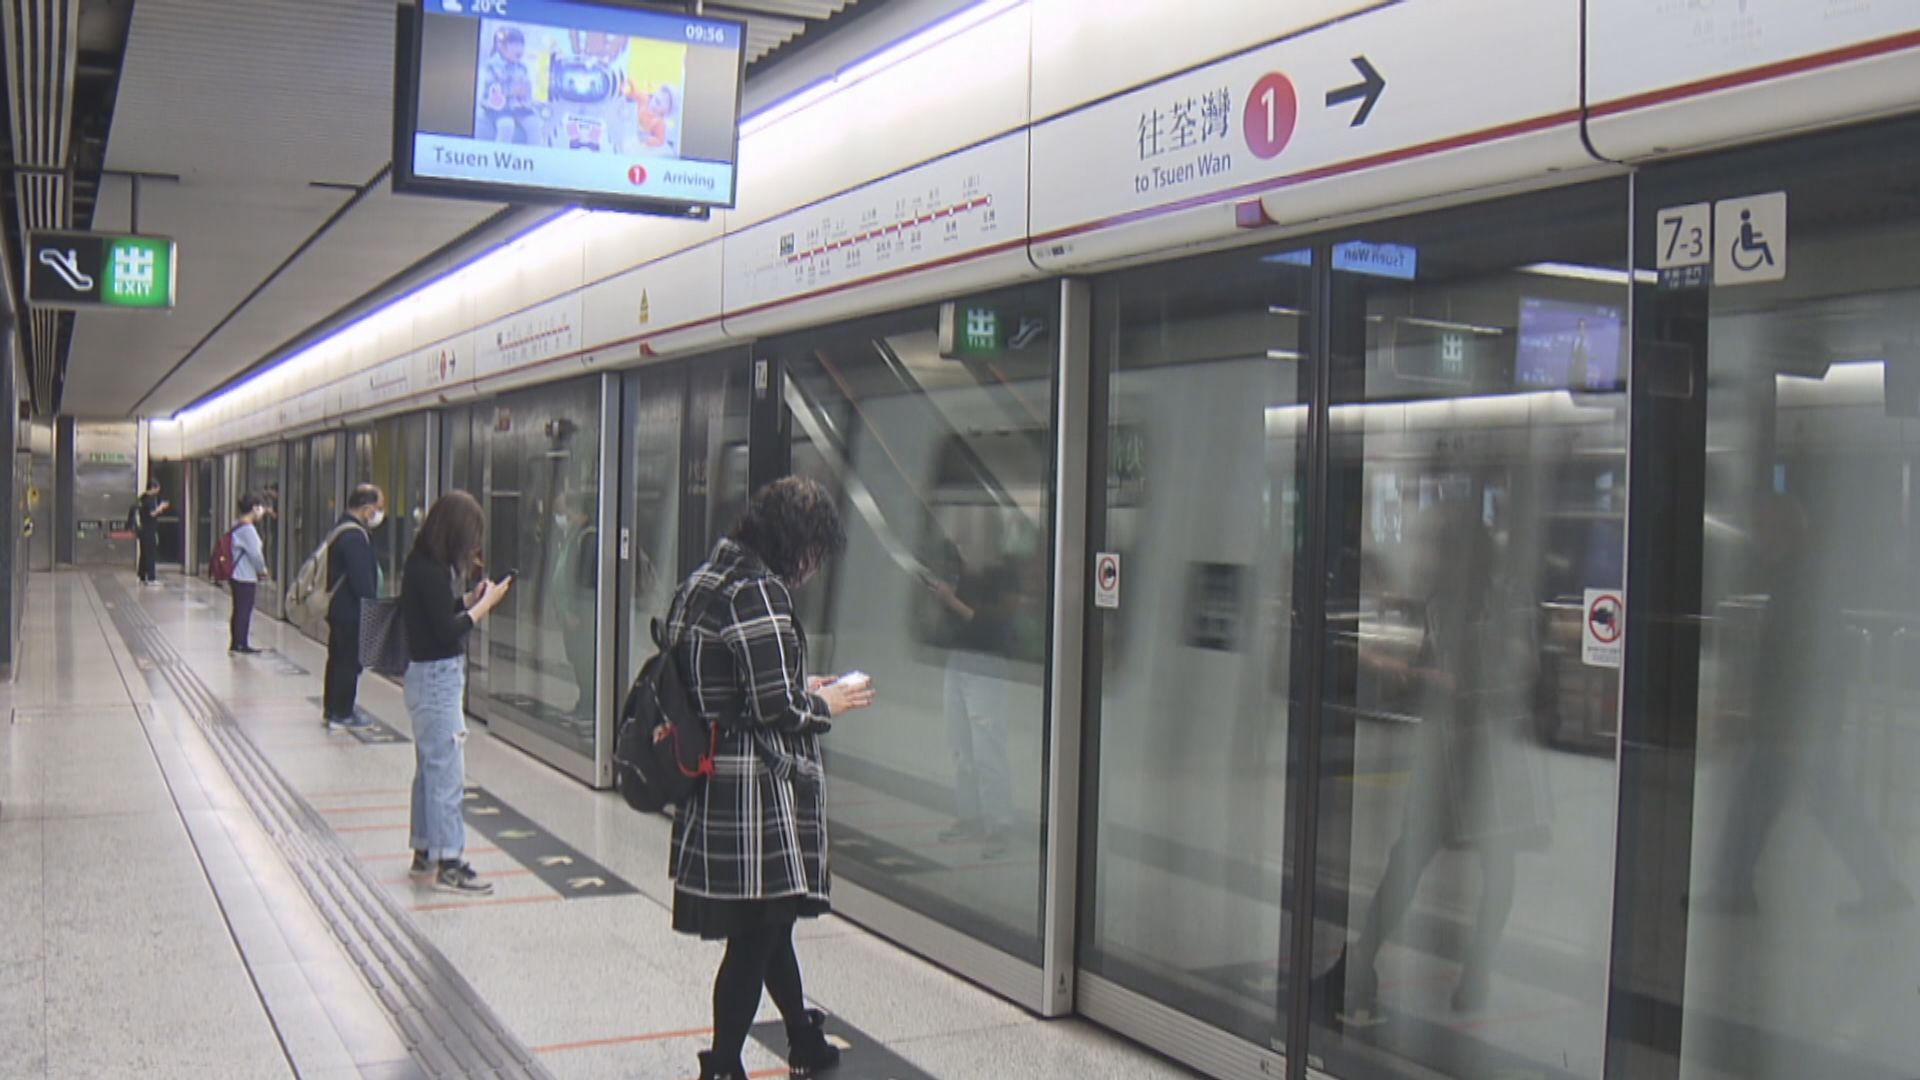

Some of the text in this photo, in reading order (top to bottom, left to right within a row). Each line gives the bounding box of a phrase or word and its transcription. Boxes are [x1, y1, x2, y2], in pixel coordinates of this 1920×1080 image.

[686, 24, 725, 43] 09:56
[1137, 86, 1231, 161] 往荃灣
[1261, 87, 1275, 144] 1
[434, 145, 534, 172] Tsuen Wan
[1135, 152, 1231, 194] to Tsuen Wan
[663, 170, 716, 191] Arriving
[1663, 216, 1703, 261] 7-3
[114, 280, 152, 296] EXIT
